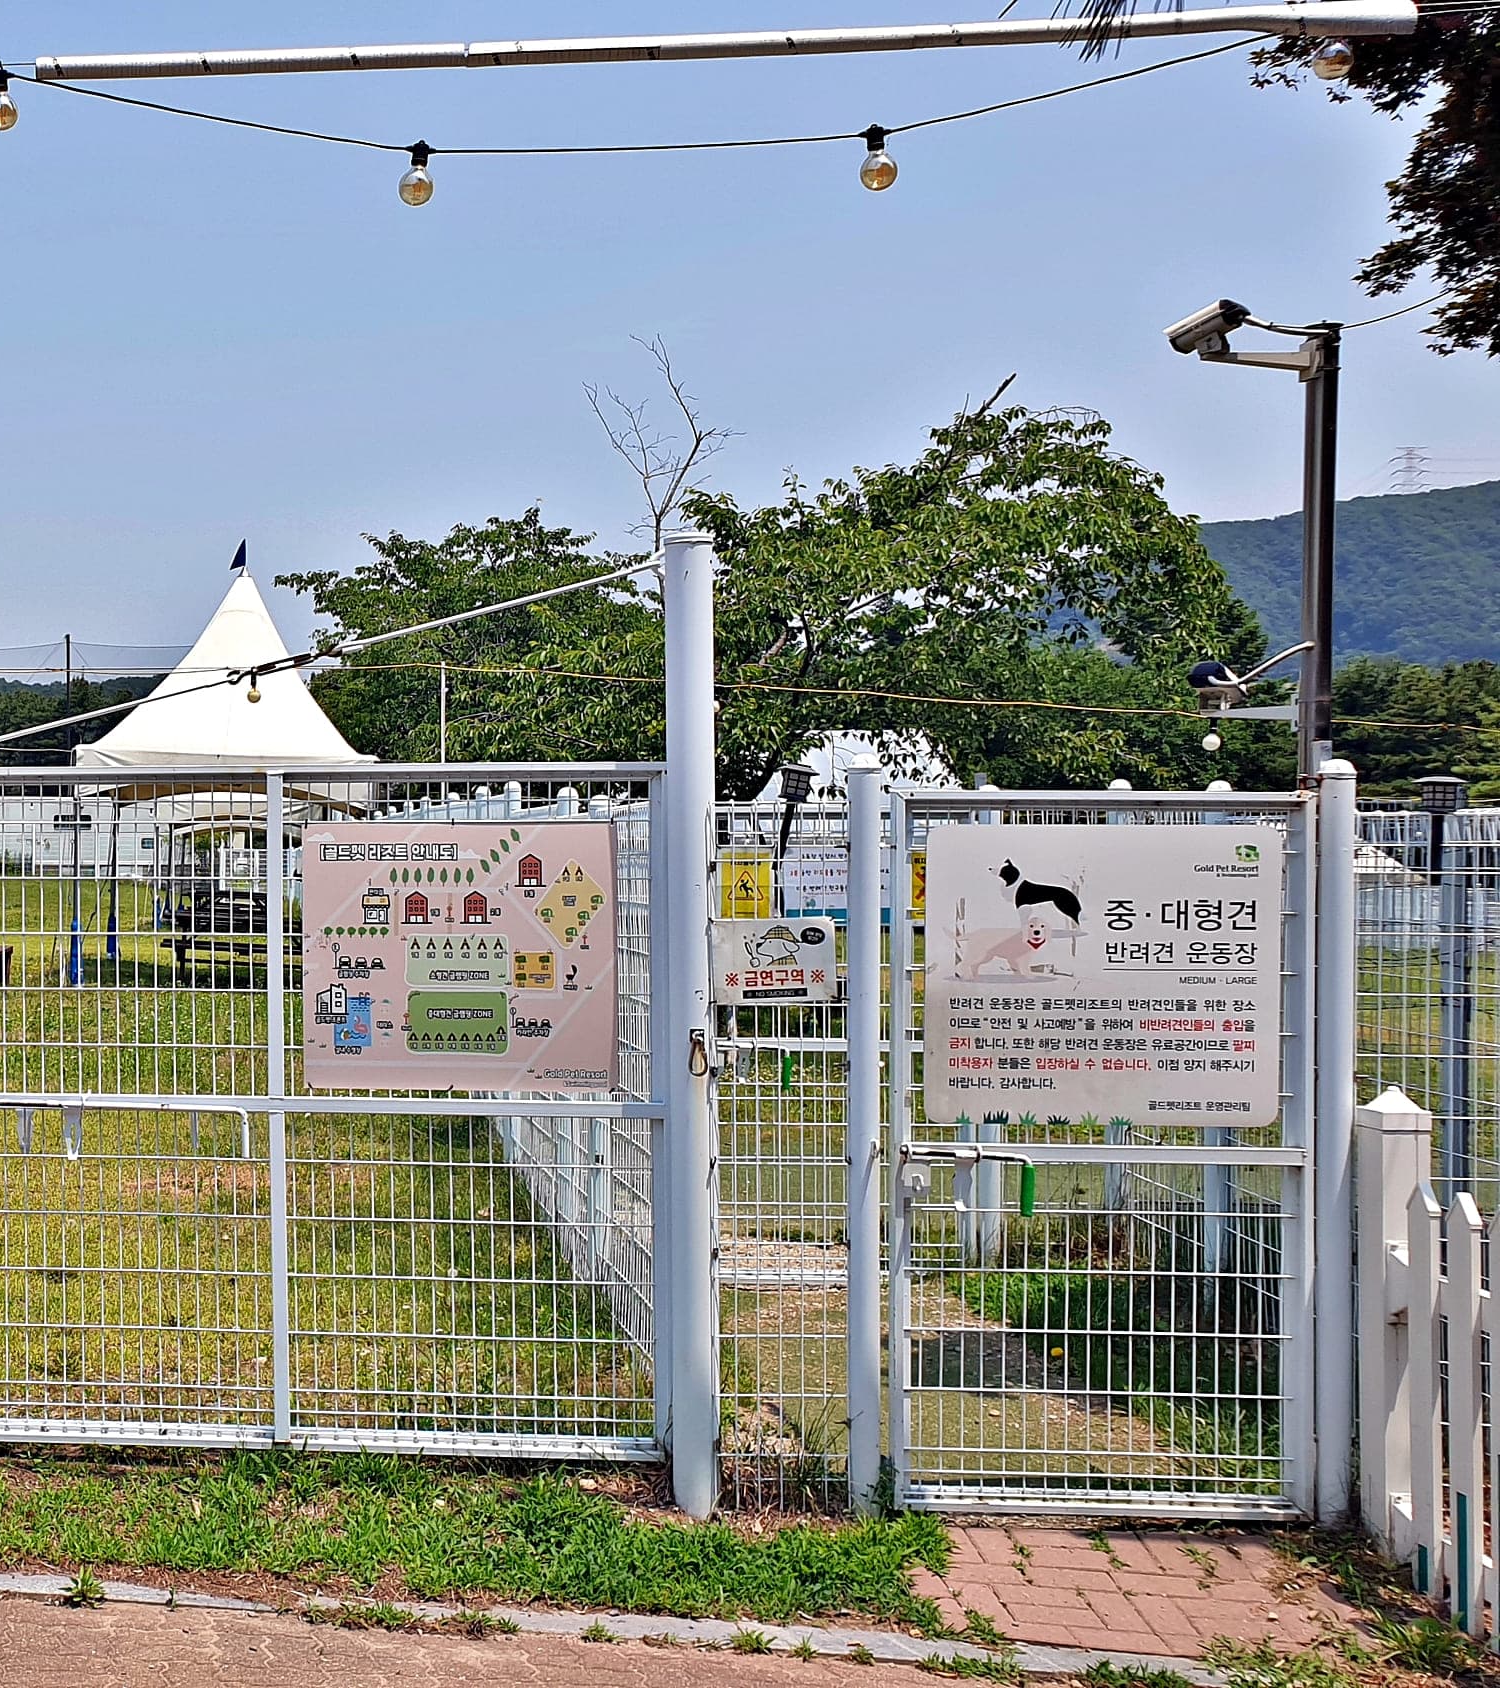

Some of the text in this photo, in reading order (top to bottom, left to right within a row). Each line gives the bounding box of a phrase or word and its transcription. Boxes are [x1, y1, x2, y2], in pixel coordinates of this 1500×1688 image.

[368, 844, 408, 861] 리조트
[411, 844, 458, 861] 안내도]
[1194, 865, 1259, 873] Gold Pet Resort
[1105, 942, 1258, 965] 반려견 운동장
[469, 970, 489, 980] ZONE
[744, 969, 804, 987] 금연구역
[1179, 976, 1216, 985] MEDIUM
[1225, 976, 1257, 985] LARGE
[949, 998, 1256, 1012] 반려견 운동장은 골드펫리조트의 반려견인들을 위한 장소
[473, 1009, 493, 1018] ZONE
[1017, 1018, 1028, 1029] 및
[1101, 1019, 1133, 1031] 위하여
[1139, 1019, 1215, 1031] 비반려견인들의
[1221, 1019, 1256, 1032] 출입을
[949, 1037, 1255, 1052] 금지 합니다. 또한 해당 반려견 운동장은 유료공간이므로 팔찌
[949, 1057, 1255, 1072] 미착용자 분들은 입장하실 수 없습니다. 이점 양지 해주시기
[544, 1069, 608, 1079] Gold Pet Resort
[948, 1077, 1056, 1090] 바랍니다. 감사합니다.
[1148, 1100, 1251, 1112] 골드펫리조트 운영관리팀
